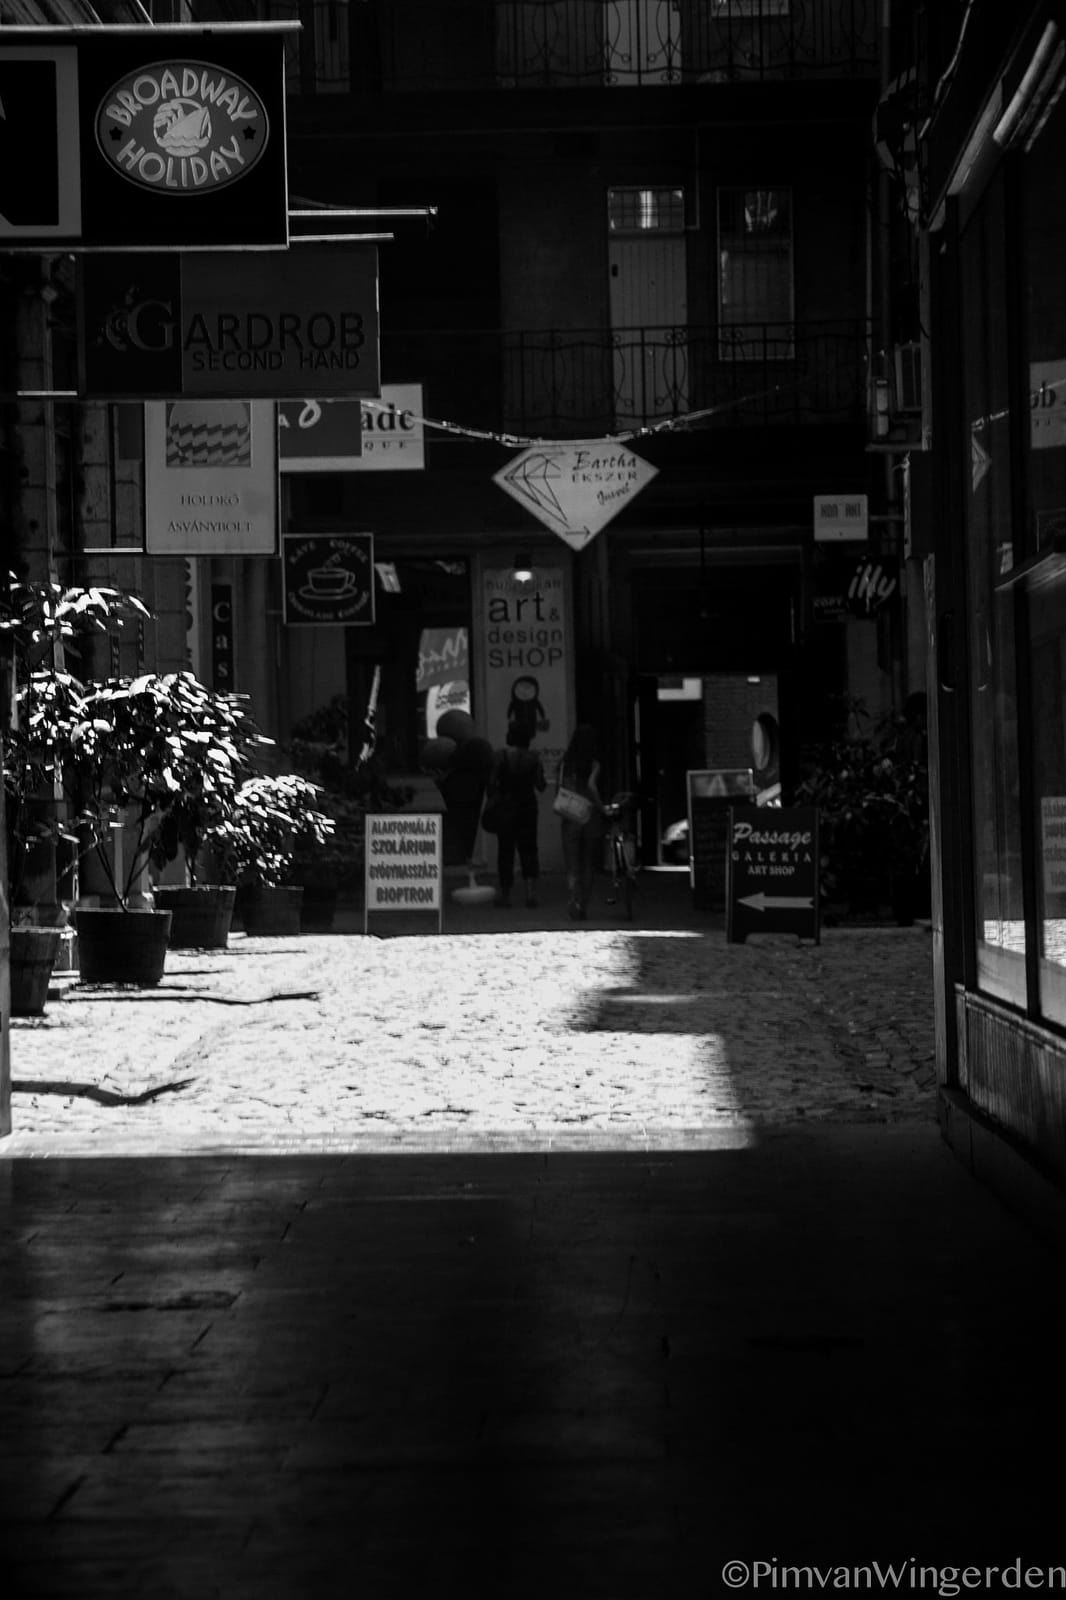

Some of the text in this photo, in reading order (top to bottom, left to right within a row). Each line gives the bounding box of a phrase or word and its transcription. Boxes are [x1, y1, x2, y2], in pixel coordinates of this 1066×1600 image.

[105, 67, 258, 127] BROADWAY
[115, 135, 245, 187] HOLIDAY
[127, 299, 365, 351] GARDROB
[192, 351, 359, 371] SECOND HAND
[489, 592, 545, 622] art
[487, 626, 563, 647] design
[489, 648, 563, 668] SHOP
[733, 822, 812, 851] Passage
[747, 864, 795, 876] ART SHOP
[376, 886, 433, 904] BIOPTRON
